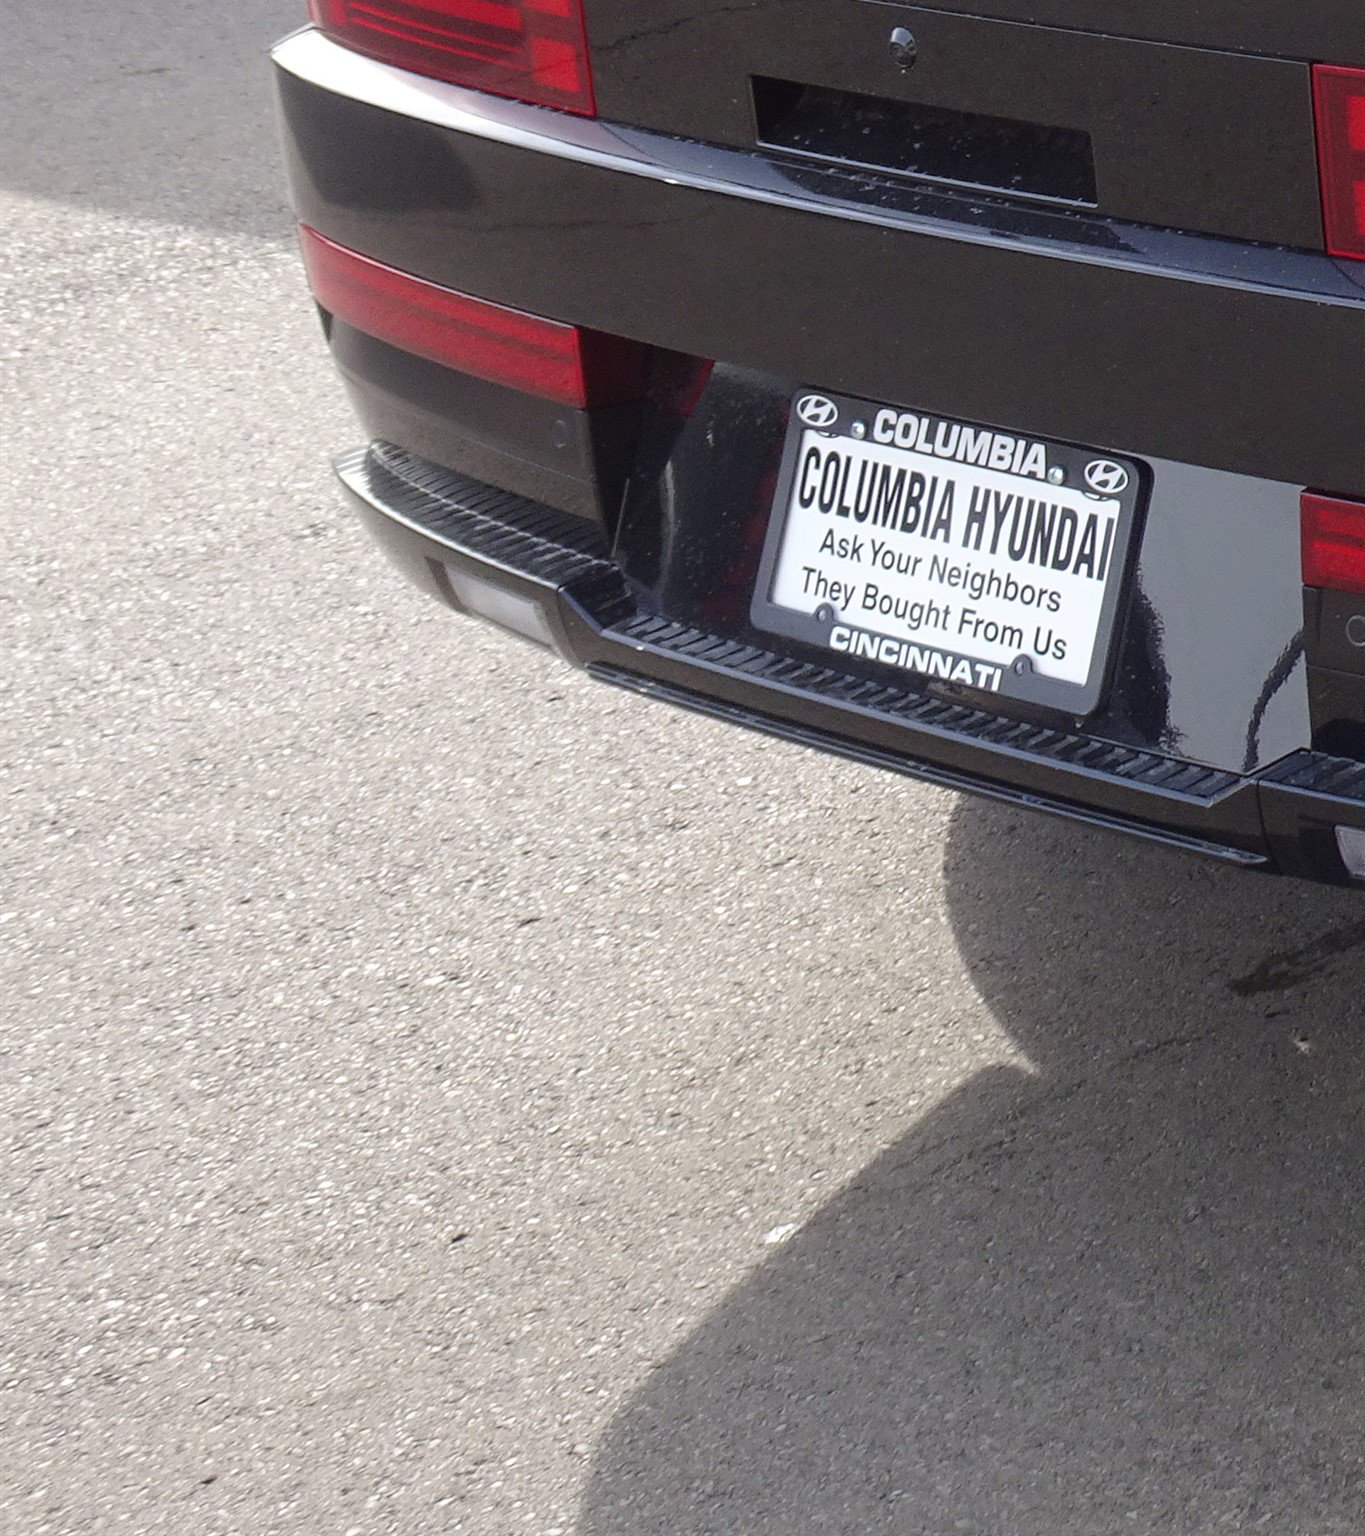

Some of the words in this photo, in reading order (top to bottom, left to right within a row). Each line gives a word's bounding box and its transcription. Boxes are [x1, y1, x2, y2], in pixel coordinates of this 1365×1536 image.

[873, 409, 1048, 479] COLUMBIA
[799, 446, 956, 543] COLUMBIA
[962, 486, 1115, 582] HYUNDAI
[802, 566, 856, 612] They
[862, 584, 951, 631] Bought
[958, 609, 1023, 649] From
[1033, 627, 1067, 660] Us
[819, 528, 863, 563] Ask
[868, 536, 923, 577] Your
[928, 555, 1061, 613] Neighbors
[829, 625, 1002, 692] CINCINNATI
